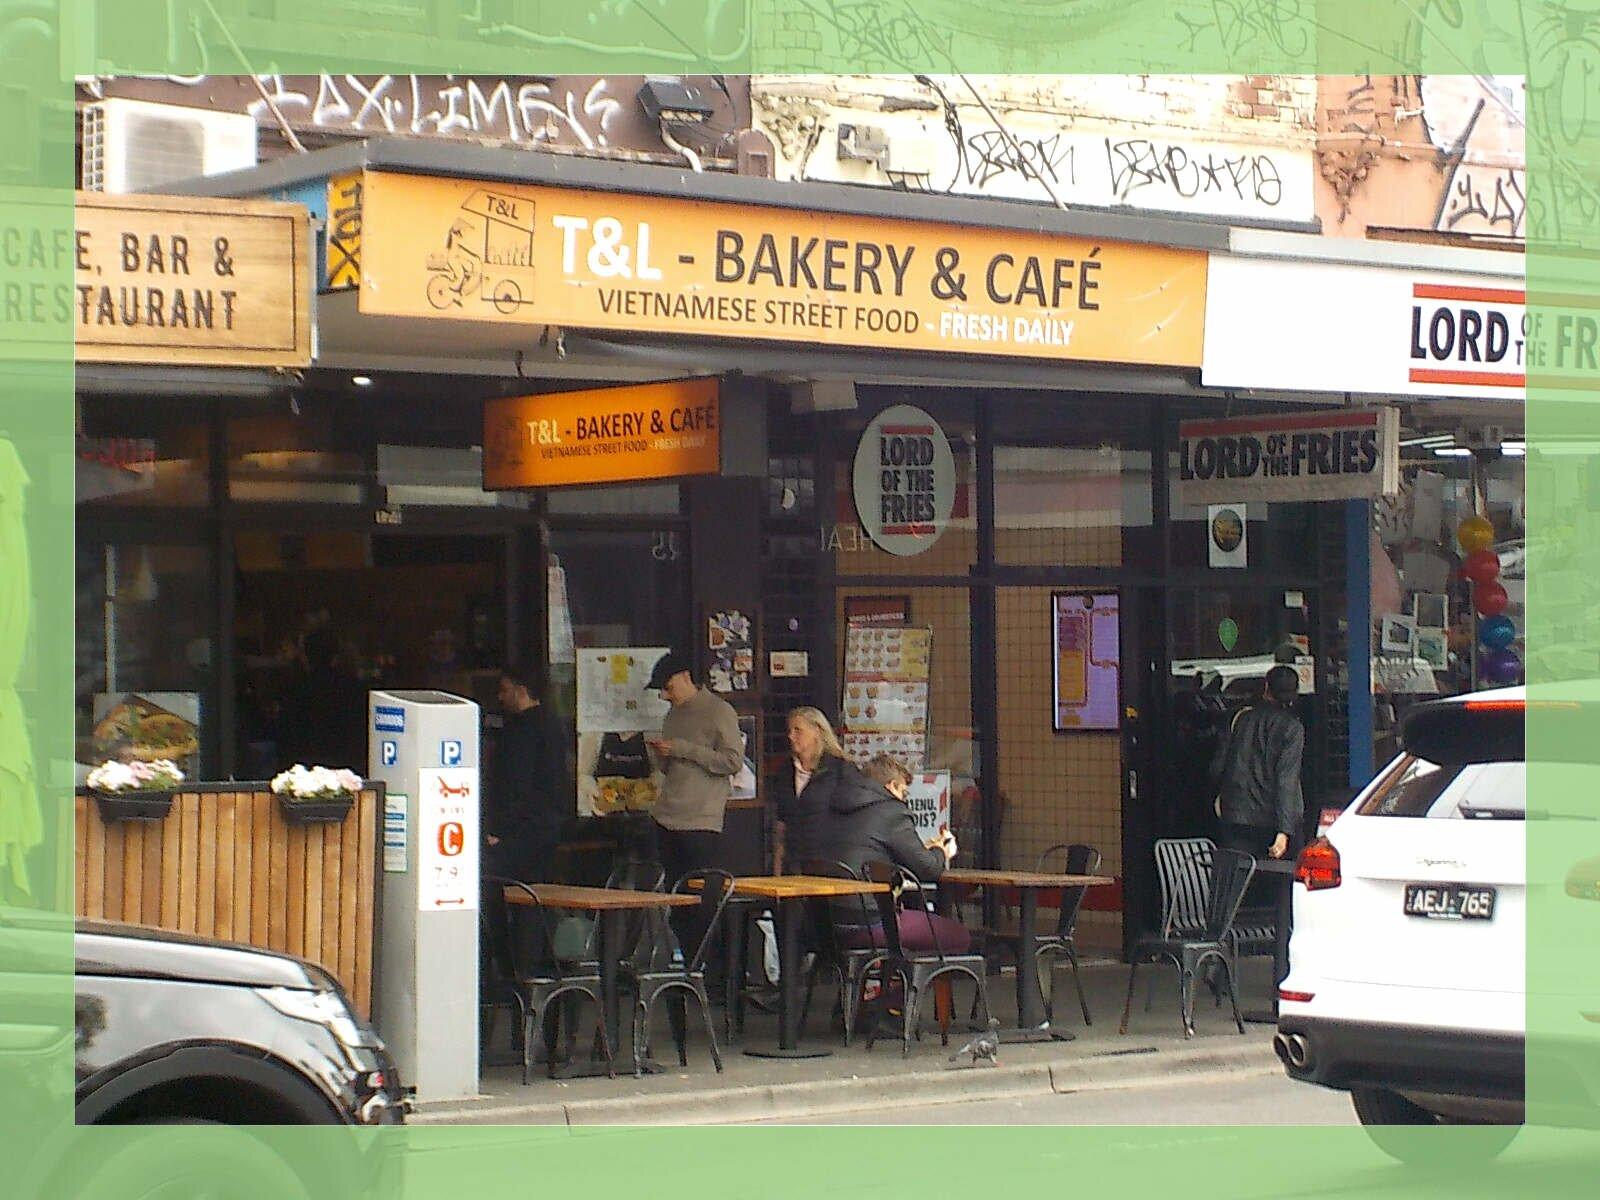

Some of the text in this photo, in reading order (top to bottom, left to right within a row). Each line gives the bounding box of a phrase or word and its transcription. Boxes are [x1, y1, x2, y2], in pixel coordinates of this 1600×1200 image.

[486, 194, 519, 220] T&L
[120, 231, 189, 275] BAR
[213, 236, 236, 277] &
[551, 214, 662, 281] T&L
[715, 229, 915, 297] BAKERY
[930, 246, 968, 301] &
[986, 246, 1102, 310] CAFÉ
[5, 282, 238, 330] RESTAURANT
[598, 288, 757, 323] VIETNAMESE
[763, 299, 848, 332] STREET
[855, 308, 919, 334] FOOD
[940, 312, 1008, 343] FRESH
[1013, 316, 1074, 346] DAILY
[1410, 306, 1510, 363] LORD
[1520, 312, 1543, 338] OF
[1514, 340, 1546, 367] THE
[527, 419, 562, 446] T&L
[576, 412, 645, 441] BAKERY
[649, 409, 664, 433] &
[540, 443, 593, 461] VIETNAMESE
[880, 436, 934, 467] LORD
[1180, 430, 1378, 481] LORD OF THE FRIES
[881, 469, 935, 492] OF THE
[881, 493, 936, 523] FRIES
[383, 741, 396, 765] P
[444, 741, 460, 765] P
[442, 821, 462, 856] C
[1413, 889, 1449, 913] AEJ
[1458, 891, 1490, 916] 765
